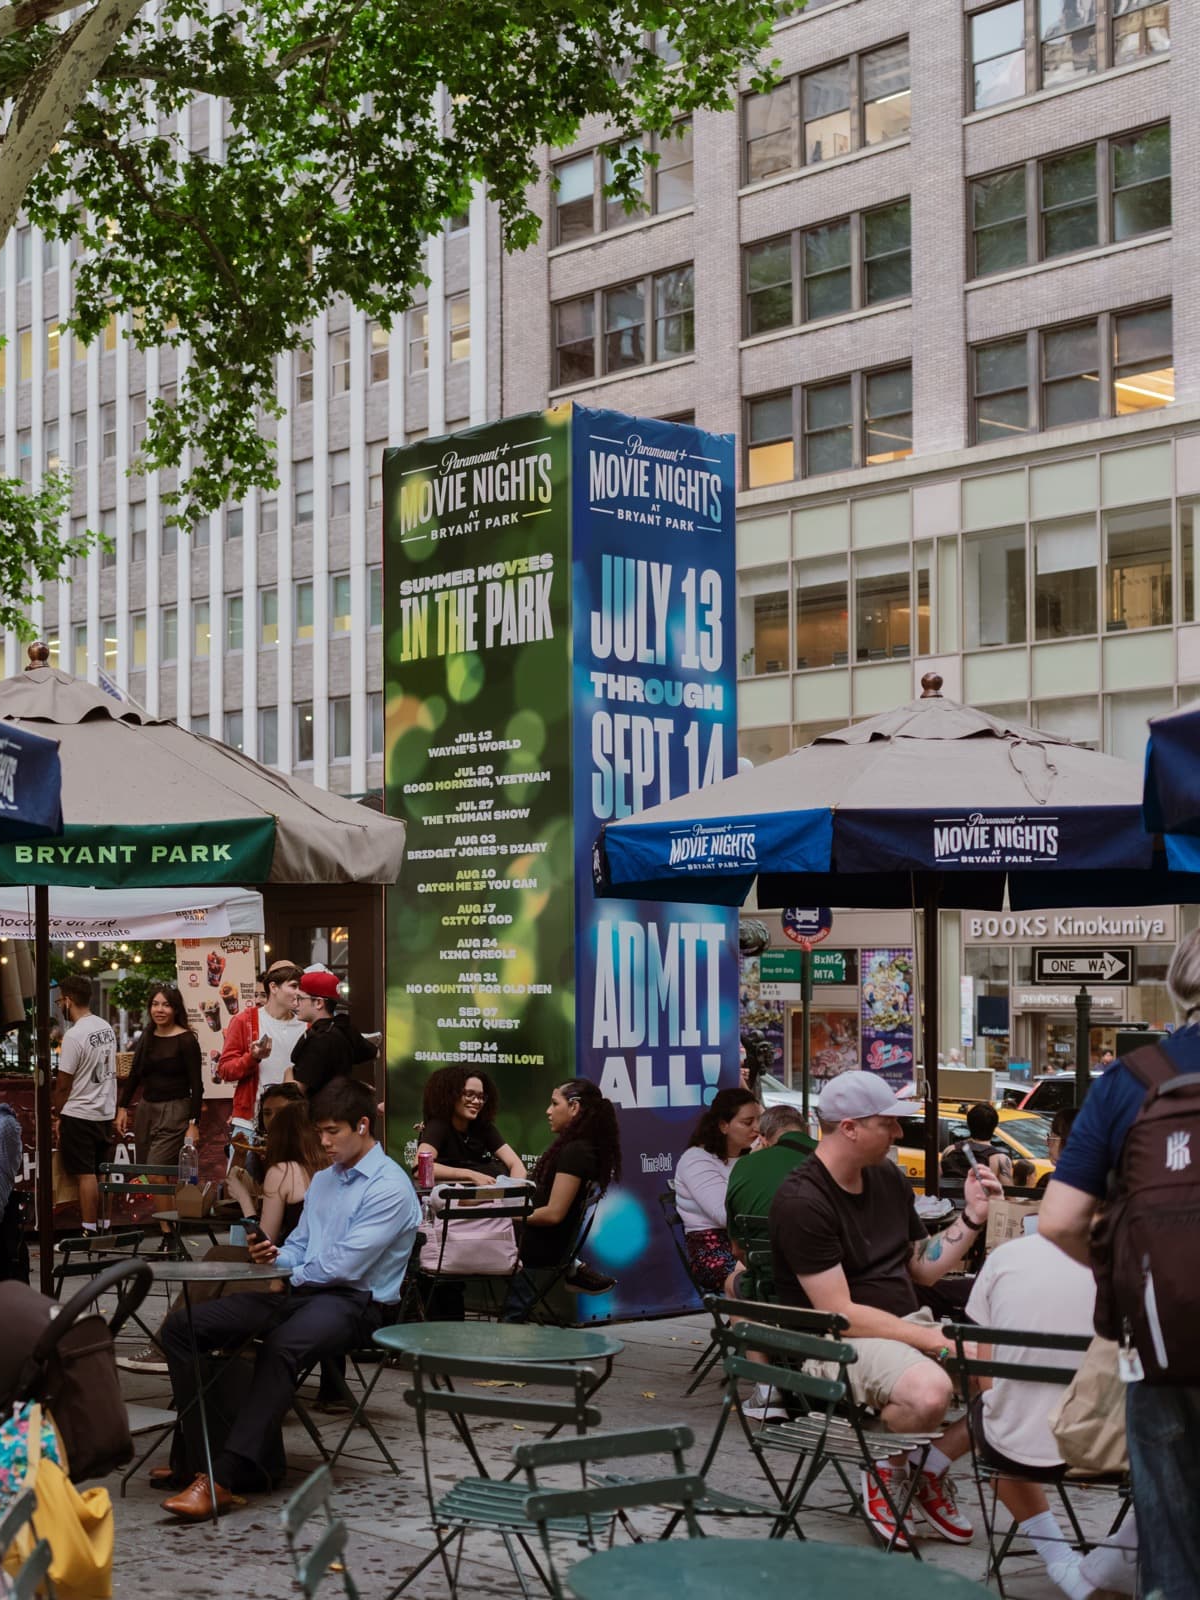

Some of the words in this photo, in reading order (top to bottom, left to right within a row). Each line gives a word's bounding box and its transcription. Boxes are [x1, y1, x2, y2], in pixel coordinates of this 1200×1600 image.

[590, 450, 649, 502] MOVIE
[655, 463, 722, 523] NIGHTS
[400, 472, 467, 535] MOVIE
[473, 453, 552, 505] NIGHTS
[468, 509, 480, 519] AT
[650, 503, 661, 512] AT
[431, 520, 480, 540] BRYANT
[485, 512, 519, 530] PARK
[617, 509, 661, 527] BRYANT
[665, 515, 694, 532] PARK
[400, 568, 476, 595] SUMMER
[478, 553, 554, 582] MOVIES
[400, 595, 428, 662] IN
[435, 587, 478, 655] THE
[486, 571, 554, 649] PARK
[591, 554, 672, 665] JULY
[682, 568, 723, 672] 13
[590, 672, 723, 711] THROUGH
[455, 733, 476, 743] JUL
[478, 730, 493, 742] 13
[428, 743, 477, 758] WAYNE'S
[479, 739, 522, 753] WORLD
[455, 767, 476, 778] JUL
[477, 765, 494, 776] 20
[592, 711, 674, 819] SEPT
[684, 721, 723, 794] 14
[403, 782, 434, 794] GOOD
[435, 776, 494, 790] MORNING,
[495, 771, 550, 786] VIETNAM
[456, 801, 477, 812] JUL
[479, 800, 494, 810] 27
[422, 815, 443, 826] THE
[445, 811, 492, 824] TRUMAN
[493, 808, 530, 820] SHOW
[454, 836, 478, 846] AUG
[480, 834, 496, 844] 03
[934, 827, 989, 857] MOVIE
[994, 825, 1059, 855] NIGHTS
[15, 846, 136, 863] BRYANT
[151, 844, 232, 862] PARK
[407, 850, 457, 860] BRIDGET
[458, 844, 508, 857] JONES'S
[510, 842, 548, 854] DIARY
[669, 836, 709, 865] MOVIE
[711, 833, 756, 860] NIGHTS
[456, 870, 480, 880] AUG
[481, 869, 496, 879] 10
[417, 882, 454, 893] CATCH
[456, 881, 471, 891] ME
[473, 880, 487, 890] IF
[488, 880, 511, 890] YOU
[512, 879, 537, 889] CAN
[176, 908, 208, 917] BRYANT
[457, 904, 481, 914] AUG
[483, 903, 496, 913] 17
[441, 916, 470, 926] CITY
[471, 915, 487, 925] OF
[488, 914, 513, 925] GOD
[49, 930, 72, 938] with
[75, 929, 131, 938] Chocolate
[970, 917, 1047, 937] BOOKS
[1054, 915, 1164, 939] Kinokuniya
[457, 938, 481, 949] AUG
[482, 938, 498, 948] 24
[440, 950, 470, 960] KING
[471, 949, 516, 960] CREOLE
[814, 953, 842, 965] BxM2
[1051, 960, 1075, 972] ONE
[1088, 959, 1115, 972] WAY
[458, 973, 482, 983] AUG
[483, 973, 498, 983] 31
[814, 970, 834, 979] MTA
[406, 984, 422, 994] NO
[423, 984, 477, 994] COUNTRY
[478, 984, 501, 994] FOR
[502, 984, 526, 994] OLD
[527, 984, 552, 994] MEN
[592, 920, 726, 1048] ADMIT
[458, 1007, 481, 1017] SEP
[482, 1007, 498, 1017] 07
[437, 1018, 481, 1029] GALAXY
[482, 1018, 520, 1030] QUEST
[459, 1041, 482, 1051] SEP
[483, 1042, 498, 1051] 14
[415, 1052, 497, 1063] SHAKESPEARE
[498, 1054, 513, 1064] IN
[514, 1054, 544, 1065] LOVE
[599, 1054, 721, 1108] ALL!
